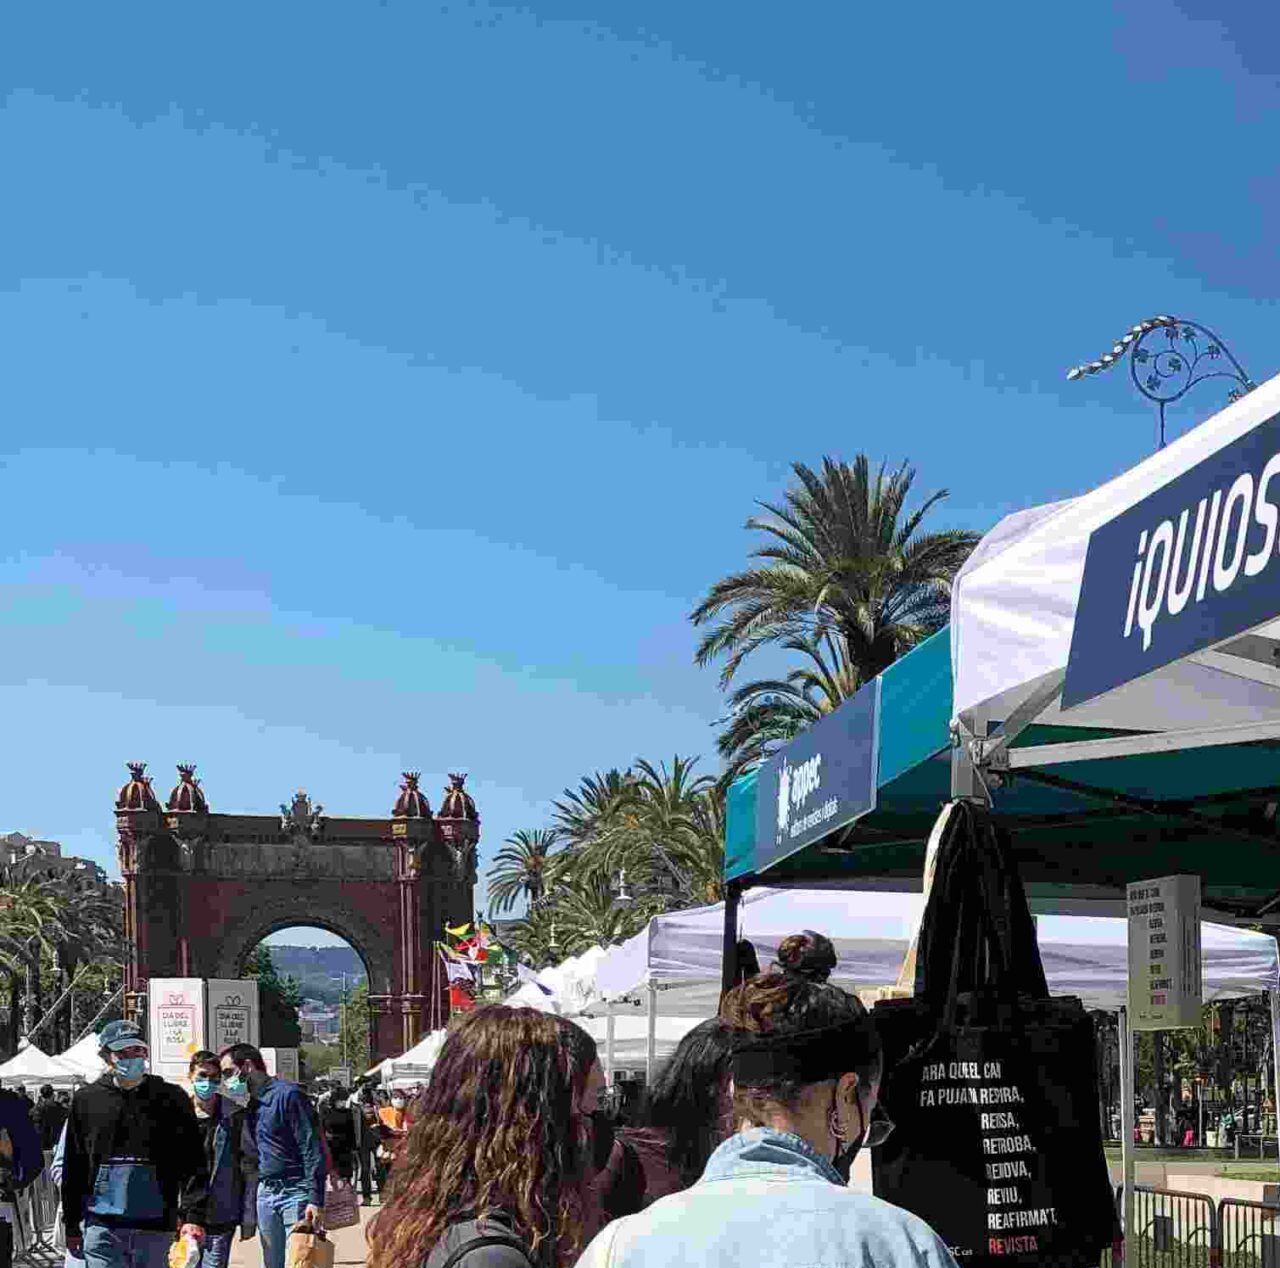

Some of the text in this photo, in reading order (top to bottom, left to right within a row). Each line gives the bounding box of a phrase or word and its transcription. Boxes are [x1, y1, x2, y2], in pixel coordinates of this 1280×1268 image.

[922, 1063, 946, 1082] ARA
[920, 1089, 935, 1107] FA
[987, 1186, 1022, 1205] REVIU,
[988, 1235, 1038, 1255] REVISTA
